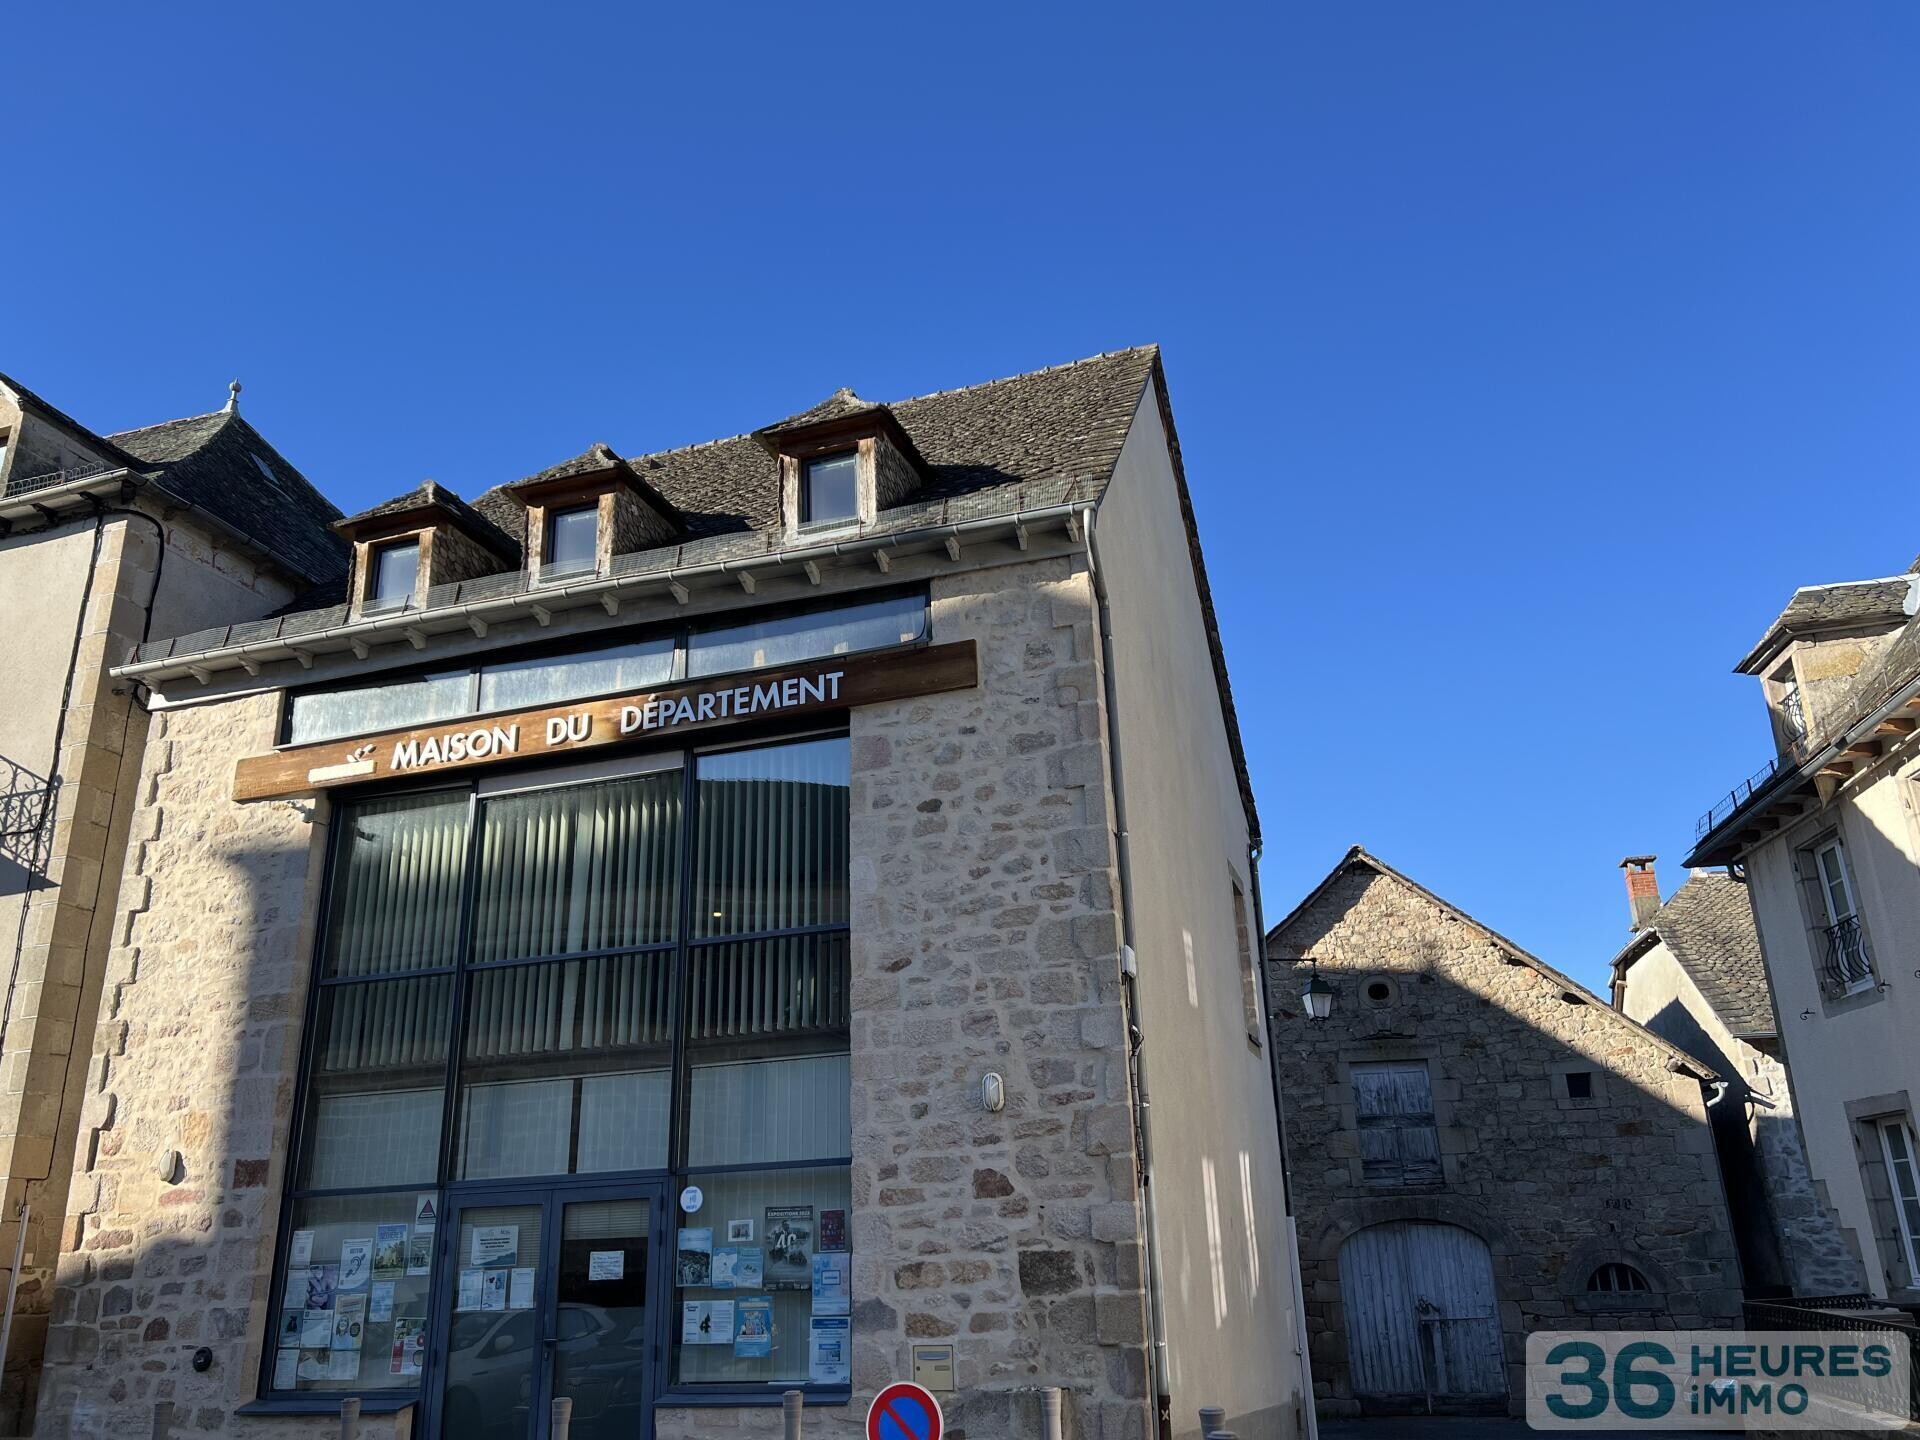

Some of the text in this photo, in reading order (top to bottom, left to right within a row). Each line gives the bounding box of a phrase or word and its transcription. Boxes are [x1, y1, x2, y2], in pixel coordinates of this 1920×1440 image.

[390, 671, 844, 771] MAISON DU DÉPARTEMENT
